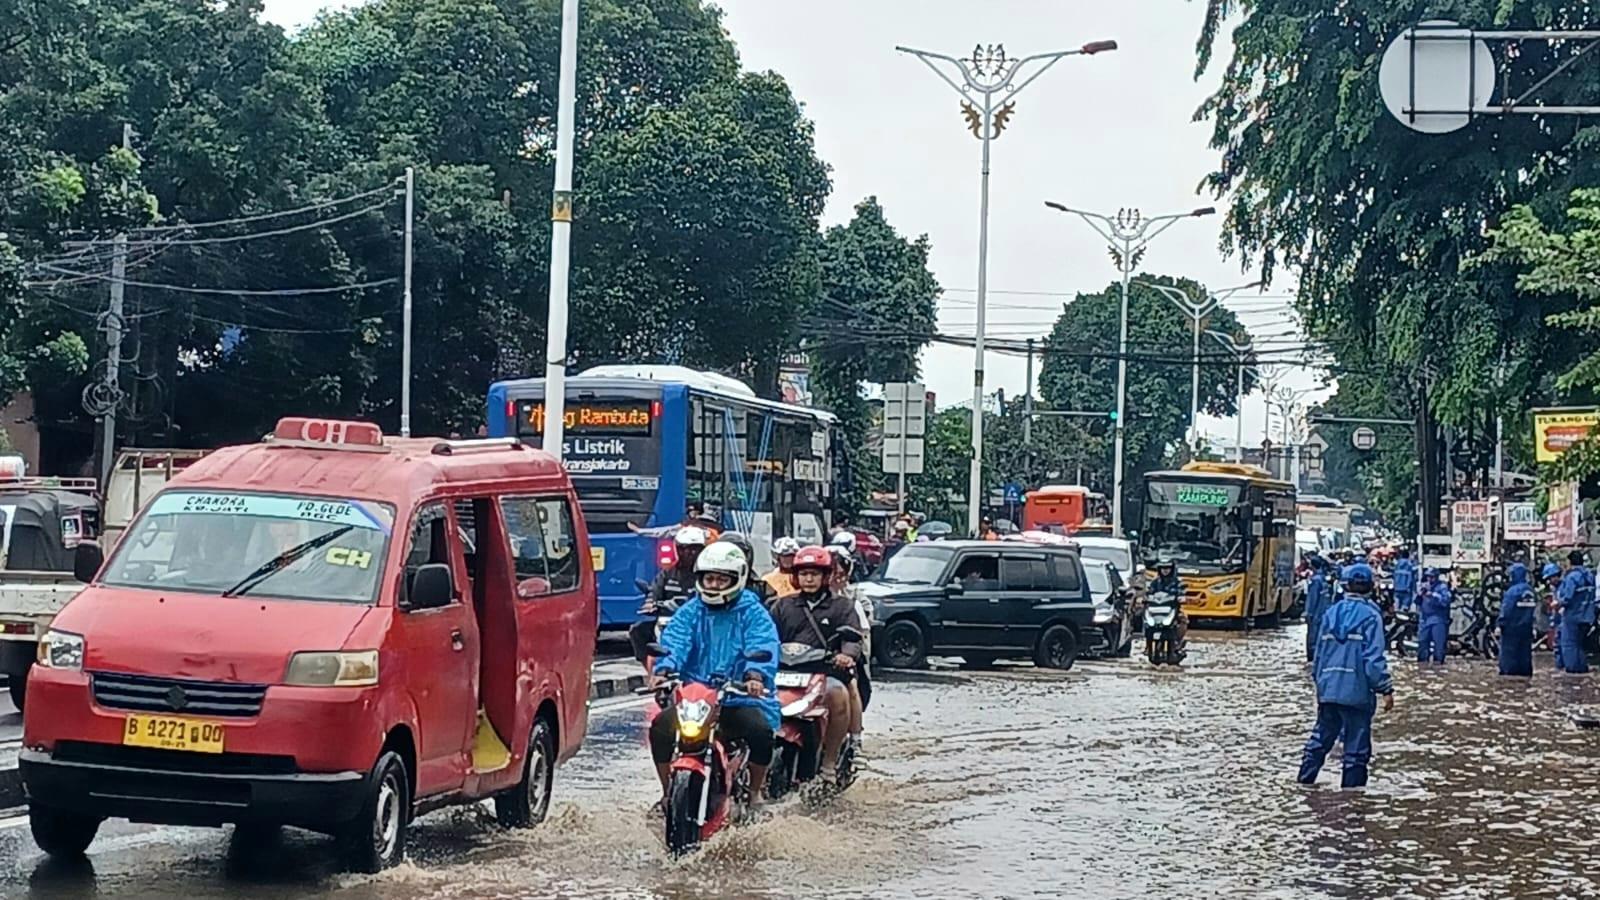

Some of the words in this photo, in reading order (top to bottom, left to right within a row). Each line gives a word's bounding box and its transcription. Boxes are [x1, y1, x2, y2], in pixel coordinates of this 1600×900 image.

[302, 420, 348, 445] CH
[575, 439, 624, 454] Listrik
[325, 547, 371, 569] CH
[128, 718, 138, 735] B
